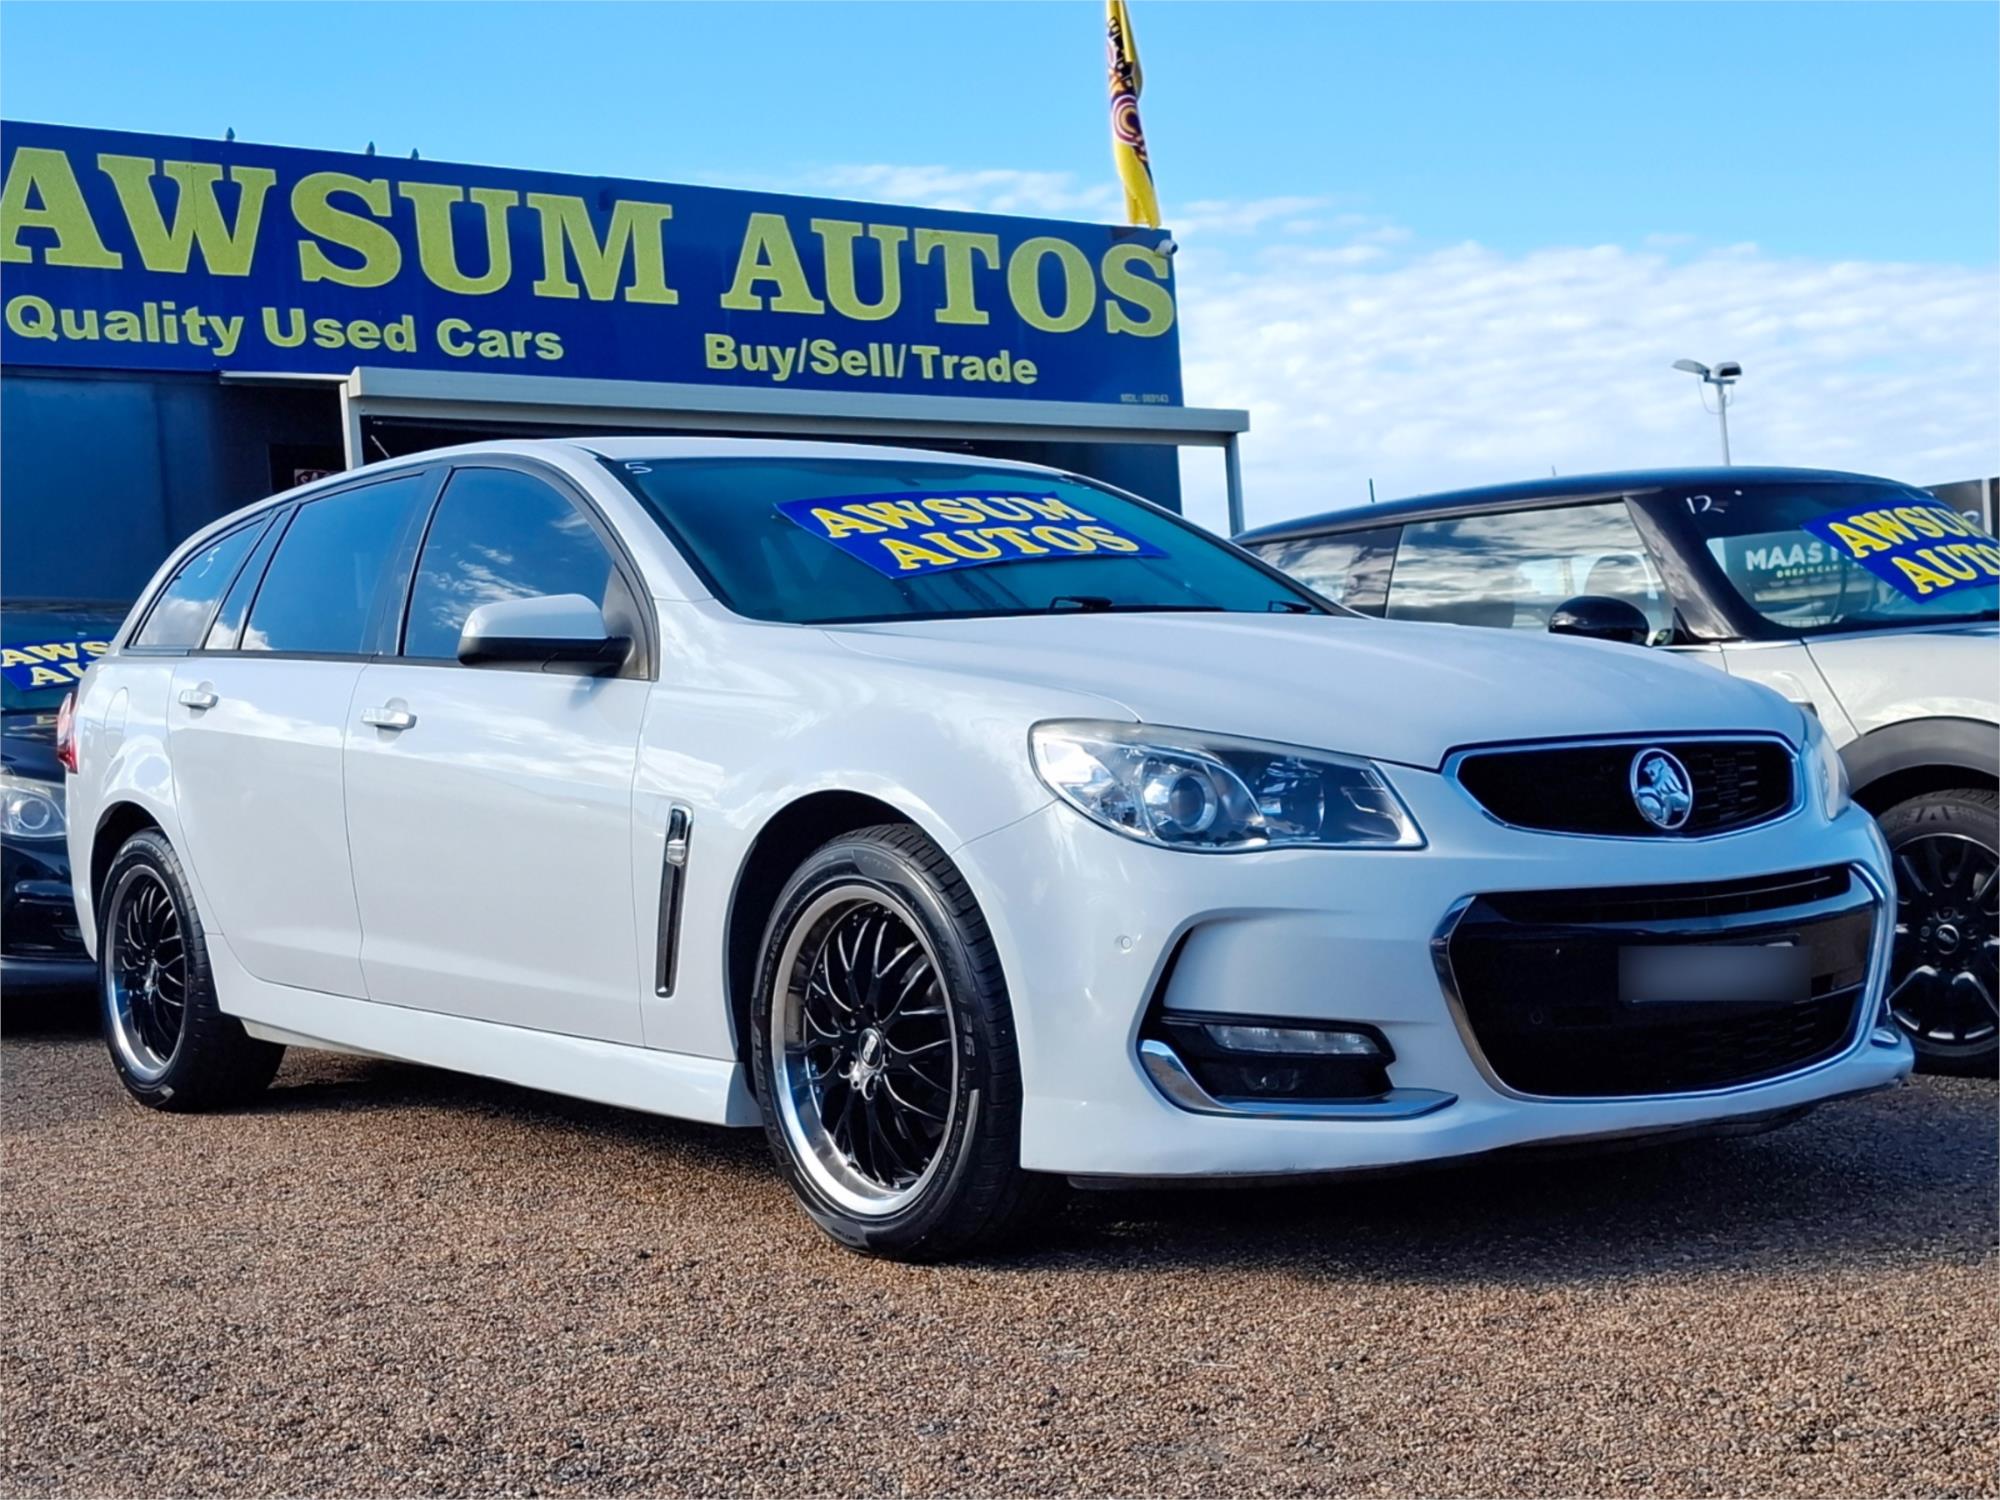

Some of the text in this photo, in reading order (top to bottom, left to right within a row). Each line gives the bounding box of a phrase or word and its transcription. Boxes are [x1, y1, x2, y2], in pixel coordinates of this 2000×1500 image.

[0, 147, 1175, 338] AWSUM AUTOS
[5, 295, 564, 360] Quality Used Cars
[704, 333, 1038, 385] Buy/Sell/Trade
[810, 497, 1098, 539] AWSUM
[879, 526, 1140, 570] AUTOS
[1745, 541, 1824, 571] MAAS
